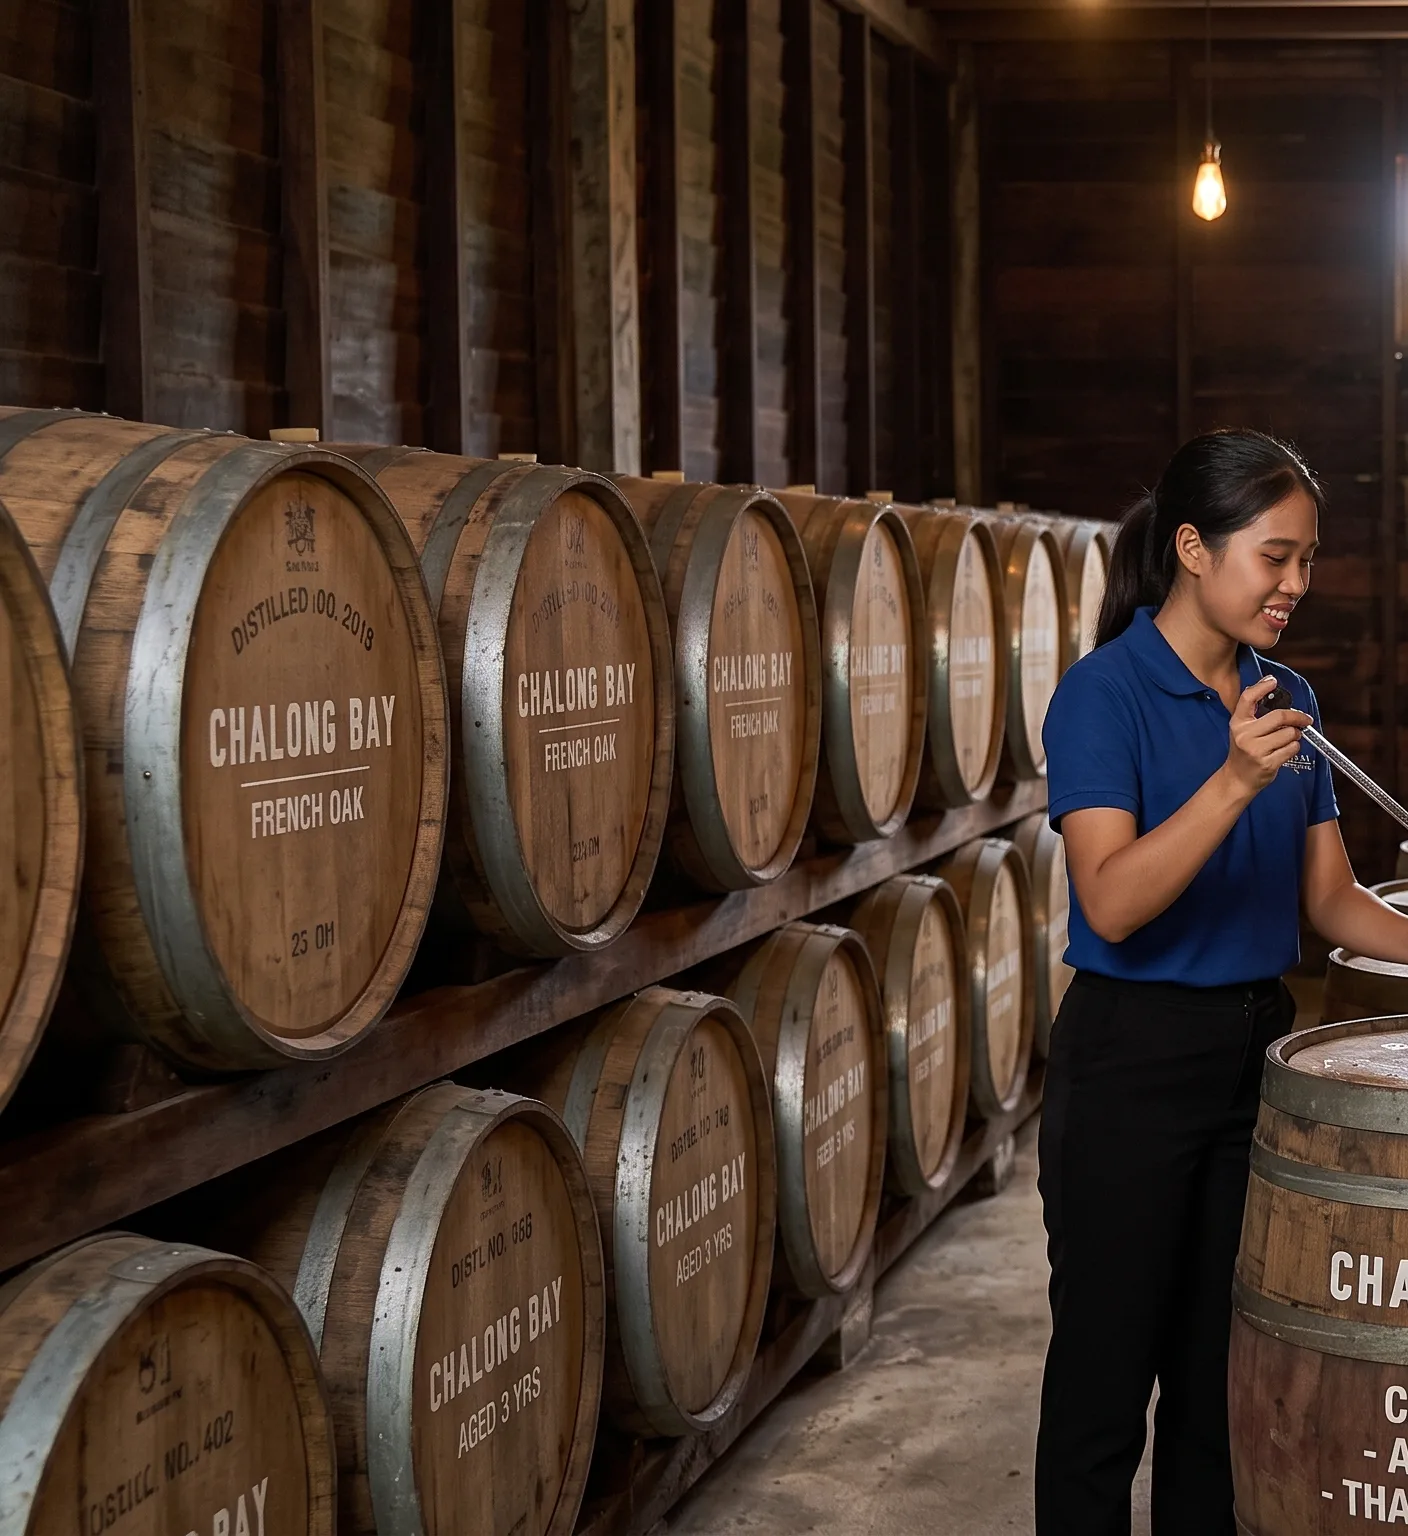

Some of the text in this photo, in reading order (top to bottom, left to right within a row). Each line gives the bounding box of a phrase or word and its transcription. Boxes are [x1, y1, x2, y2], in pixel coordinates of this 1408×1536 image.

[231, 586, 308, 656] DISTILLED
[341, 603, 375, 652] 2018
[518, 663, 636, 718] CHALONG BAY
[713, 651, 793, 693] CHALONG BAY
[209, 695, 396, 768] CHALONG BAY
[763, 709, 779, 733] OAK
[544, 733, 617, 773] FRENCH OAK
[251, 785, 365, 839] FRENCH OAK
[291, 929, 308, 958] 25
[804, 1074, 845, 1137] CHALONG
[847, 1060, 865, 1102] BAY
[656, 1151, 746, 1248] CHALONG BAY
[676, 1222, 733, 1288] AGED 3 YRS
[429, 1275, 563, 1413] CHALONG BAY
[203, 1409, 234, 1454] 402
[457, 1365, 542, 1459] AGED 3 YRS
